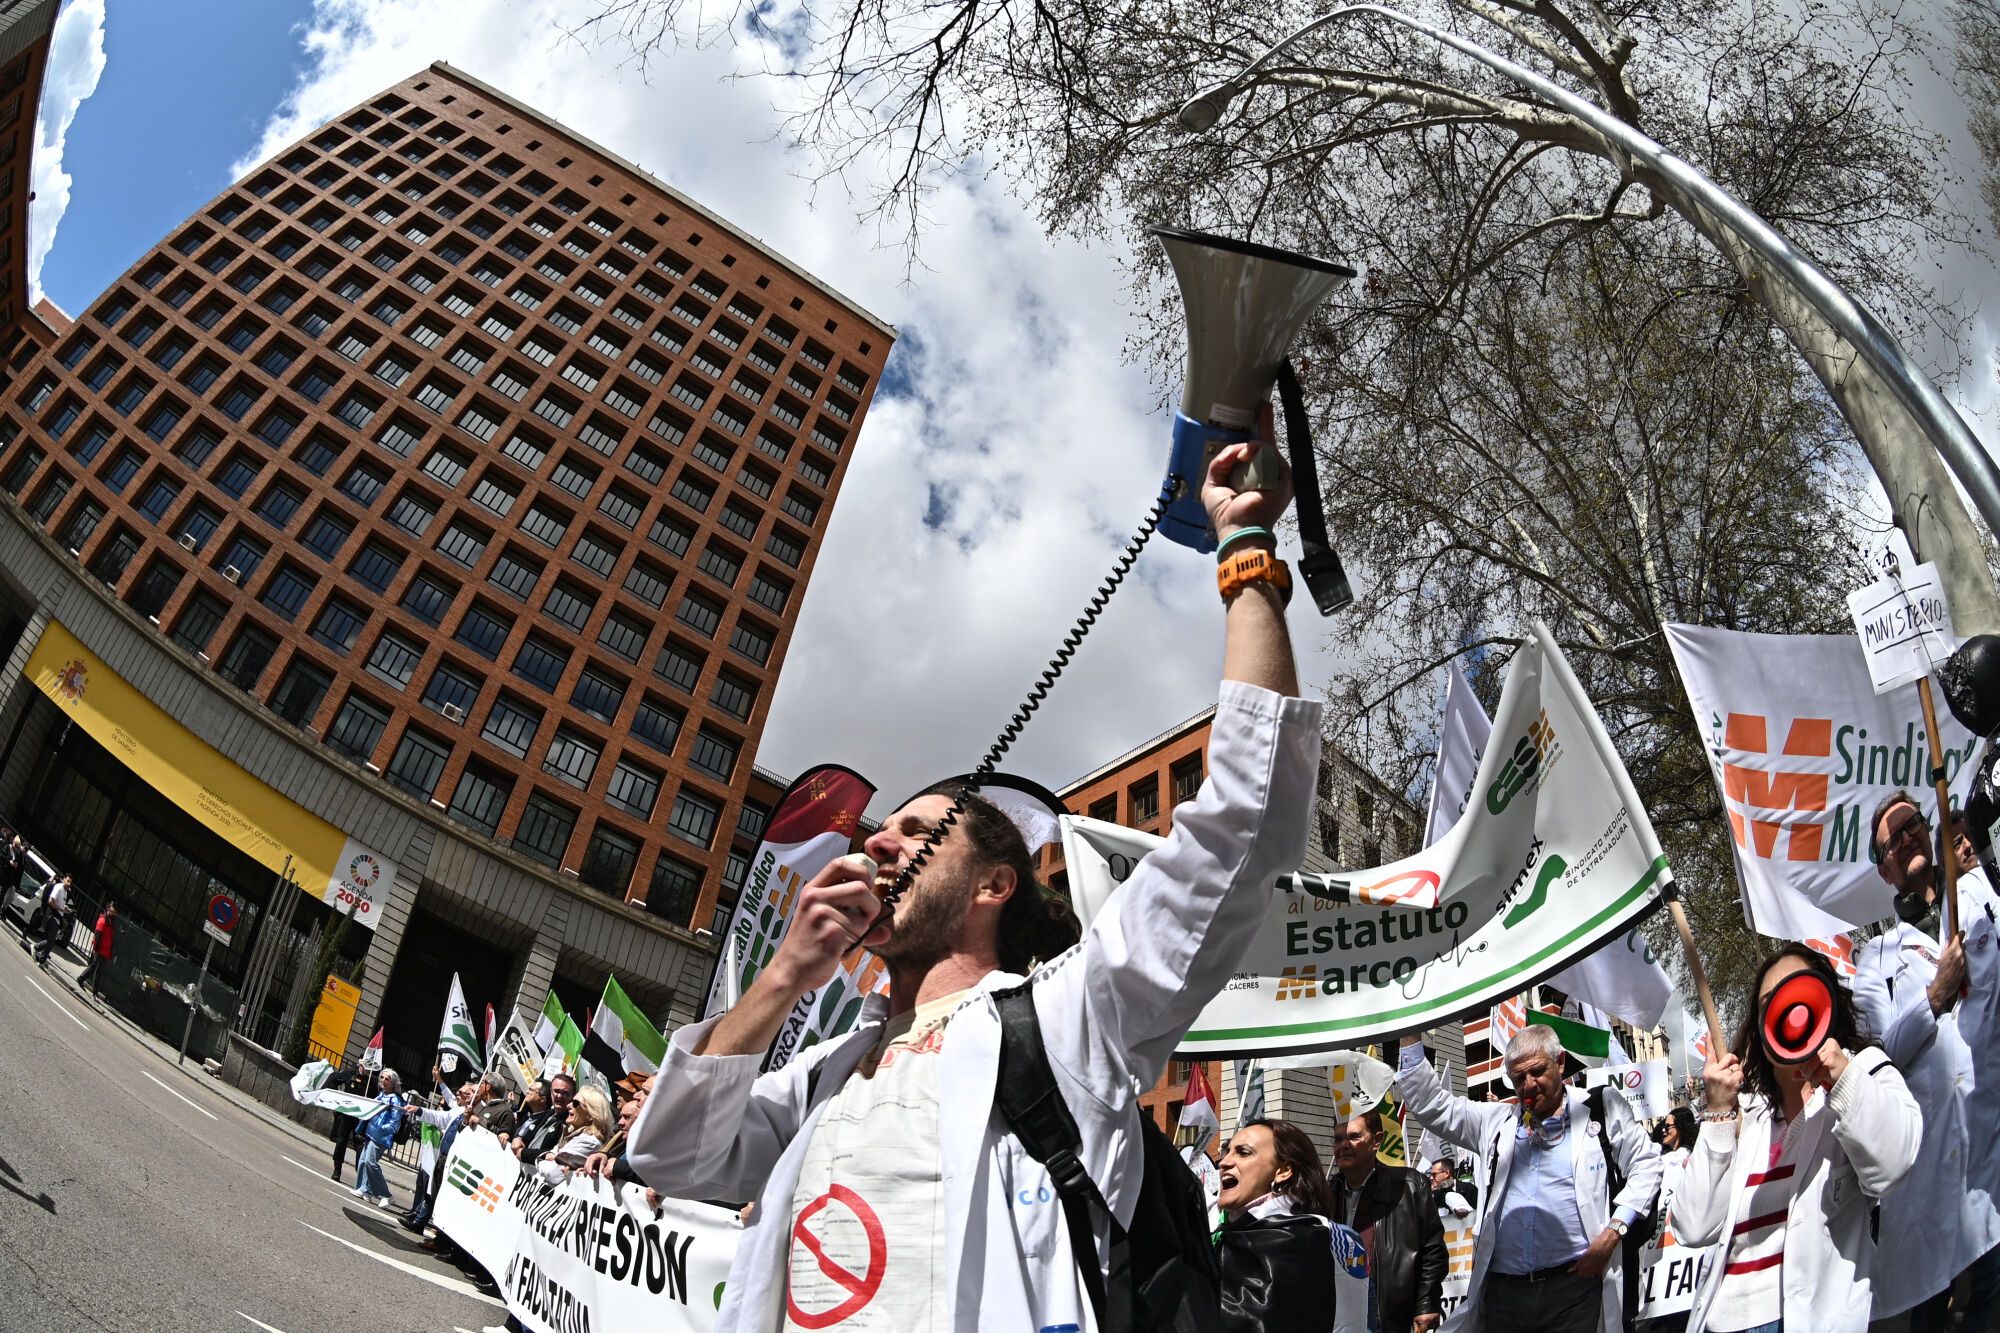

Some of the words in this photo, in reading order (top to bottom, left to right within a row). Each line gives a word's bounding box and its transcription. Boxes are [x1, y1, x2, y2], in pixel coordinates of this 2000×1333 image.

[1865, 598, 1942, 647] MINISTERIO
[254, 830, 281, 851] CONSUMO
[1565, 838, 1604, 878] SINDICATO
[1603, 806, 1627, 839] MEDICO
[1566, 875, 1579, 889] DE
[1581, 822, 1628, 878] EXTREMADURA
[340, 880, 373, 903] AGENDA
[742, 850, 776, 917] Médico
[1495, 833, 1543, 915] simex
[336, 888, 370, 913] 2030
[1286, 900, 1469, 957] Estatuto
[1275, 956, 1418, 1001] Marco
[508, 1169, 539, 1213] POR
